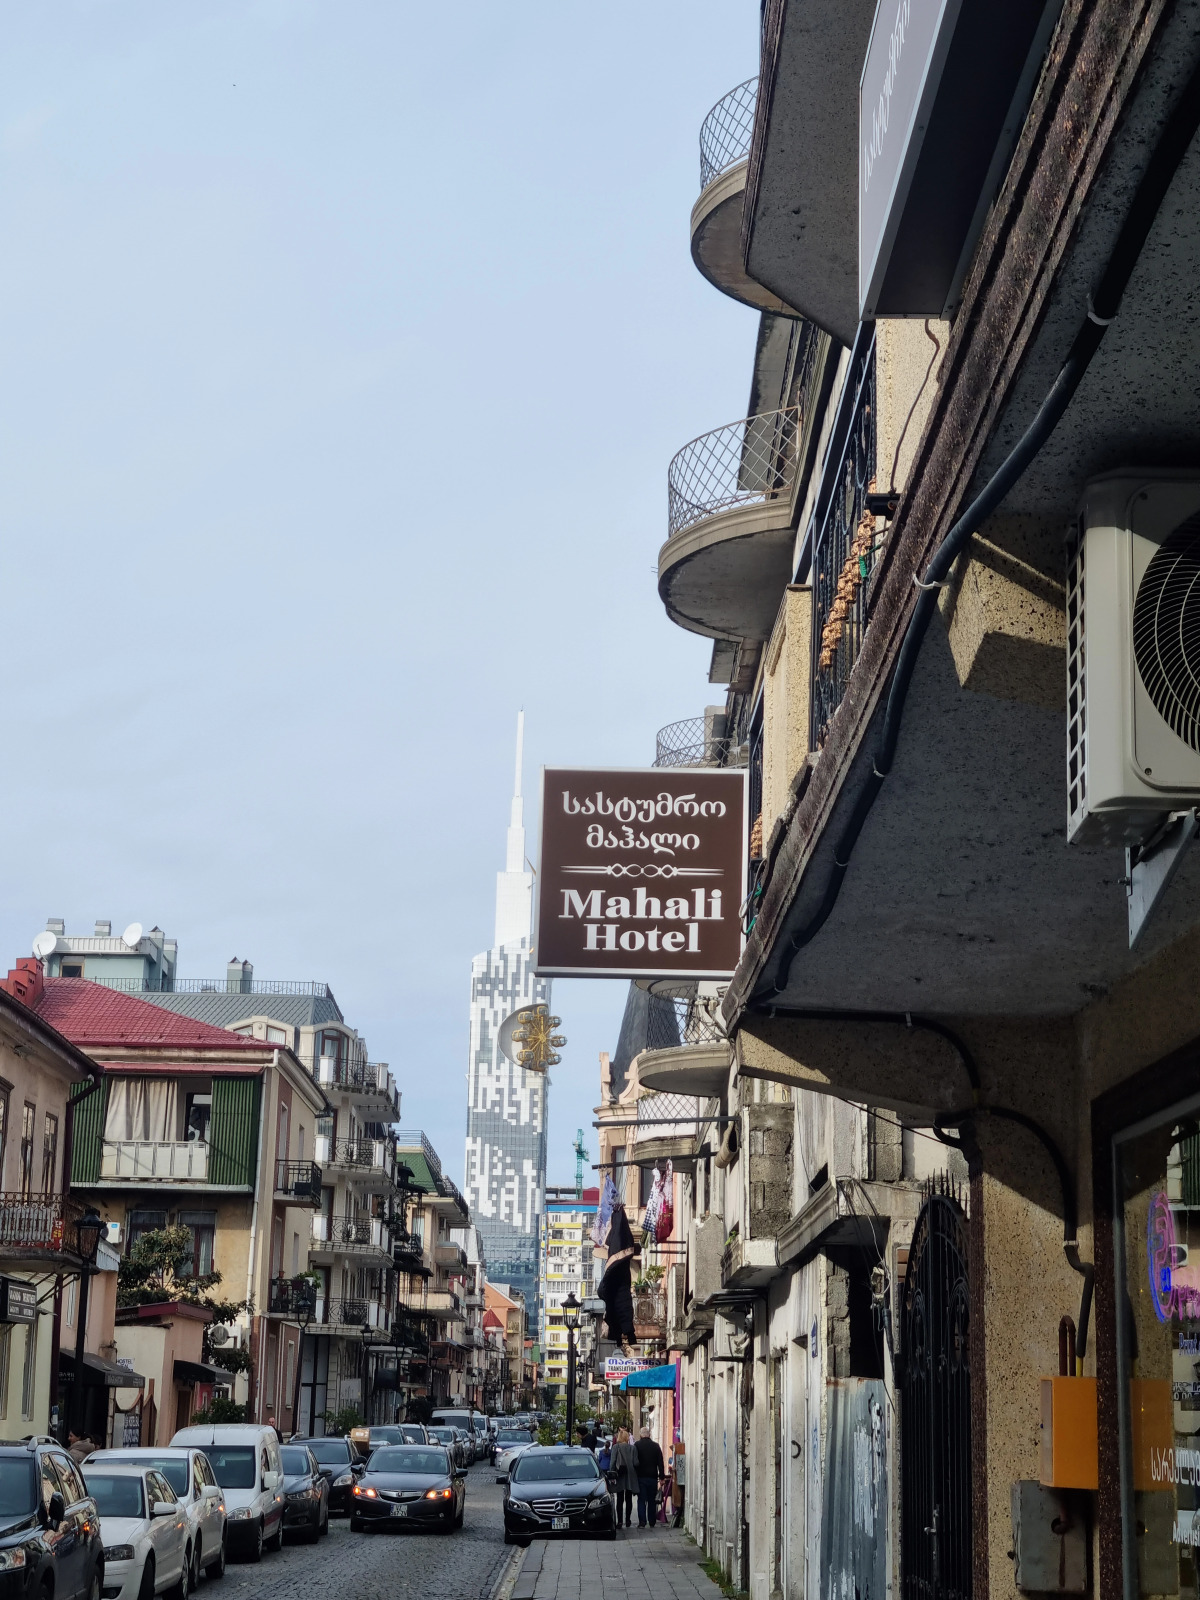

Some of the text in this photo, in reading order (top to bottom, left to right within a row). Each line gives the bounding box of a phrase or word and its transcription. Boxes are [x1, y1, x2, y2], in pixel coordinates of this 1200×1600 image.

[562, 790, 727, 823] სასტუმრო
[586, 823, 700, 856] მაჰალი
[558, 886, 725, 920] Mahali
[582, 922, 701, 952] Hotel
